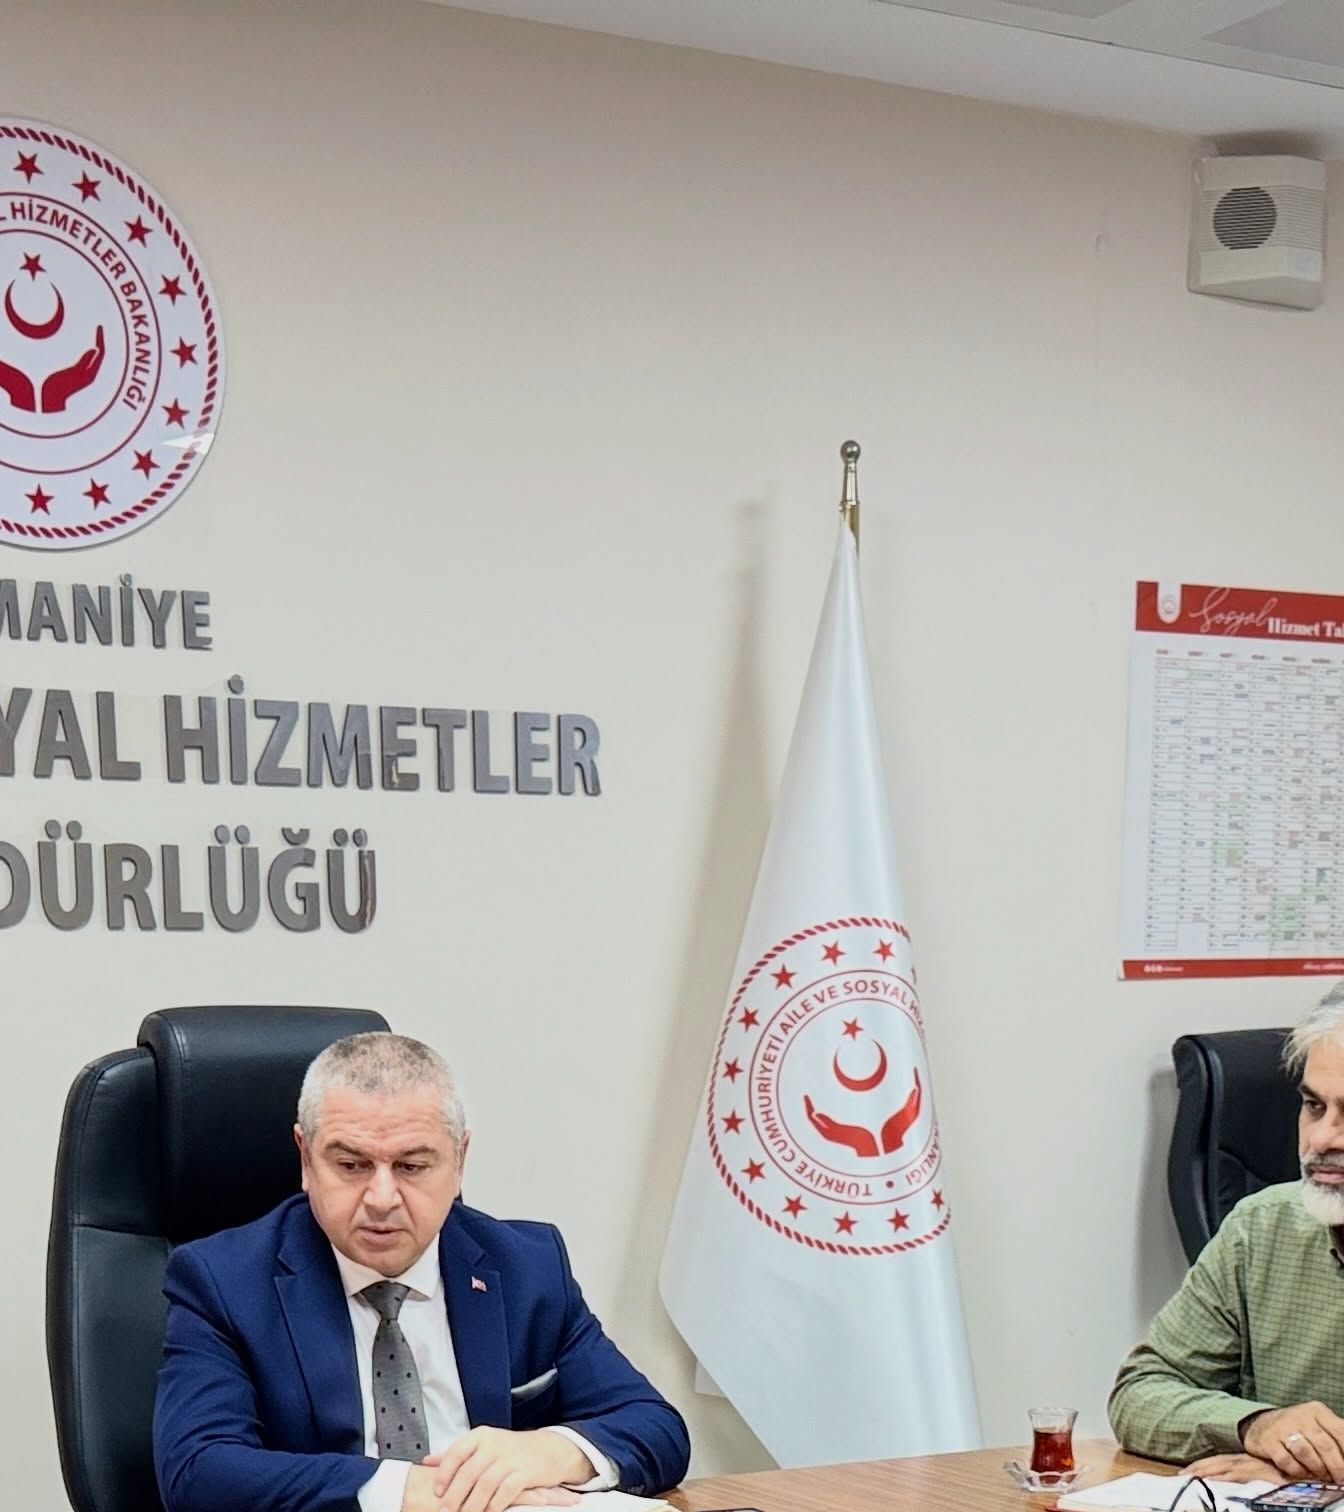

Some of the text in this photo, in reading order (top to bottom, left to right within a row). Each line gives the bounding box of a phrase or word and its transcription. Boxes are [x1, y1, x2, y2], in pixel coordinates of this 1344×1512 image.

[10, 199, 127, 280] HİZMETLER
[120, 281, 151, 411] BAKANLIĞI
[1189, 588, 1278, 636] Sosyal
[1267, 617, 1320, 637] Hizmet
[163, 674, 602, 796] HİZMETLER
[813, 985, 838, 1004] VE
[842, 980, 908, 1006] SOSYAL
[780, 999, 814, 1035] AİLE
[756, 1035, 796, 1163] CUMHURİYETİ
[795, 1161, 872, 1198] TÜRKİYE
